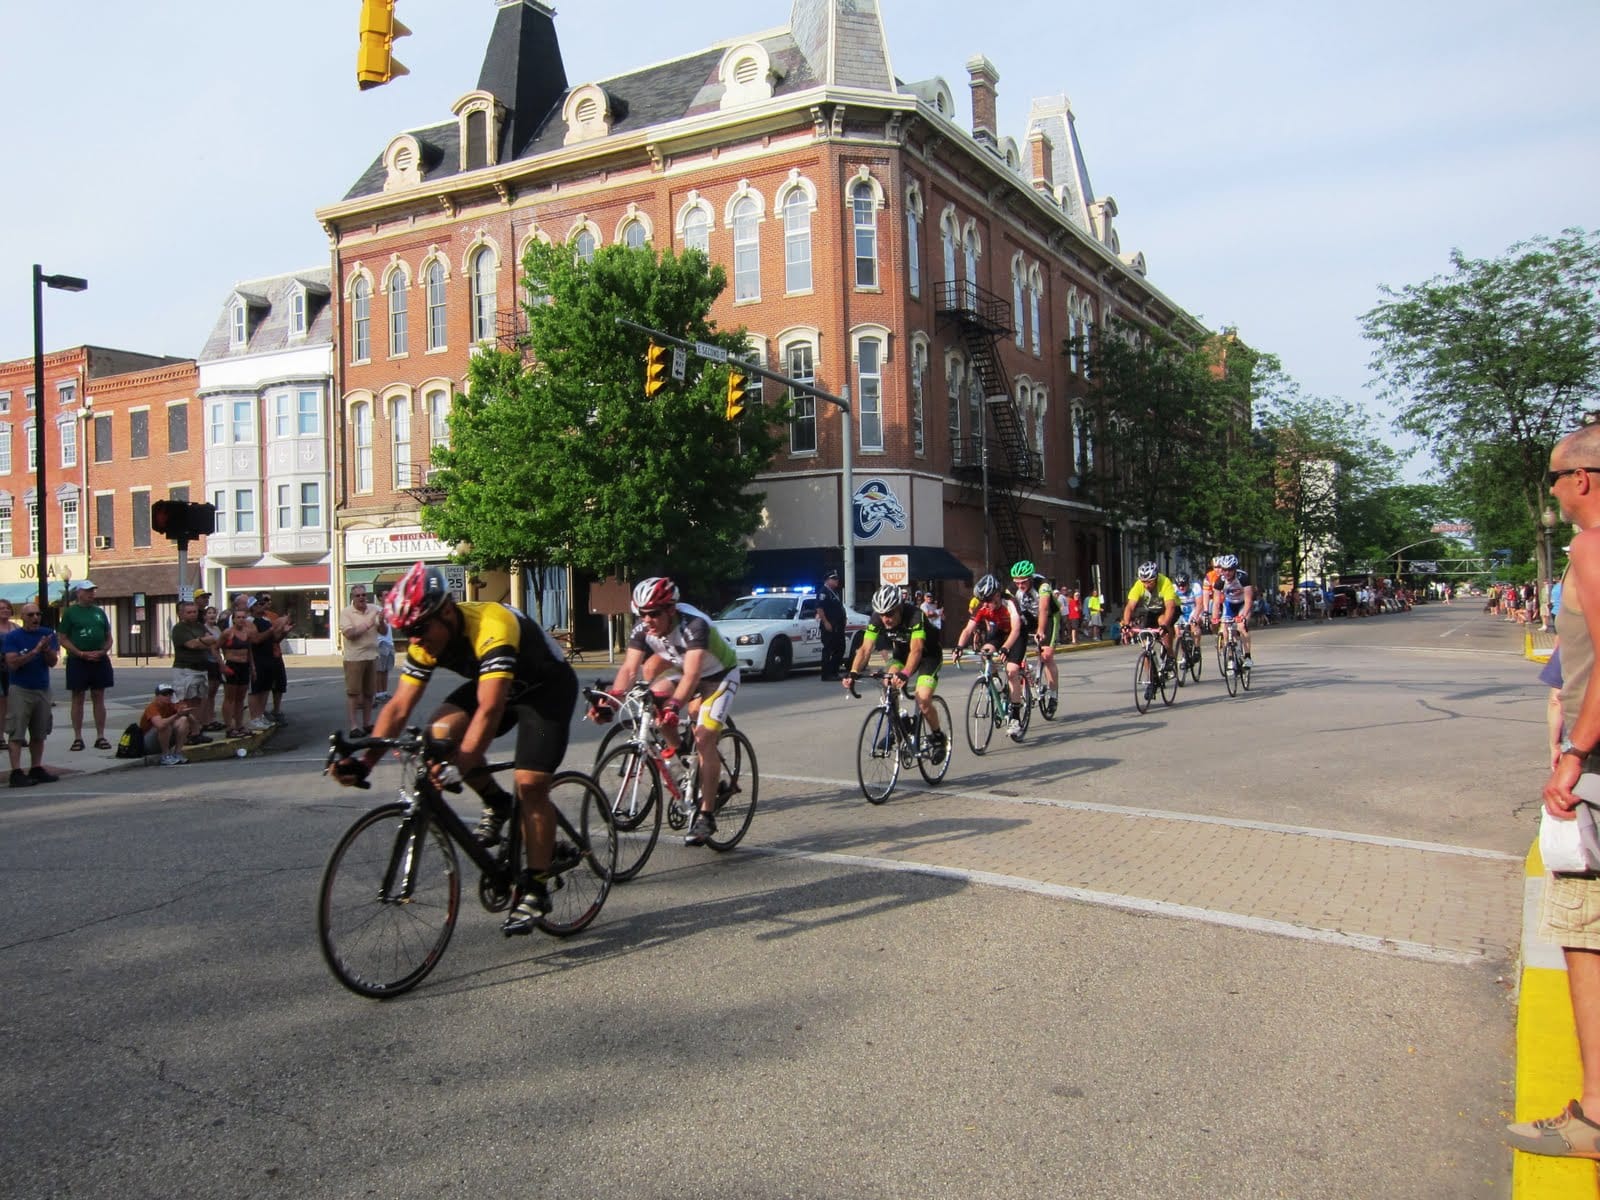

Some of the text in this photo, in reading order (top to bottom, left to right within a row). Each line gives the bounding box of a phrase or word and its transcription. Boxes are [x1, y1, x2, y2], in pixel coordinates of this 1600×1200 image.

[366, 540, 442, 554] FLESHMAN
[20, 563, 56, 578] SOA
[448, 578, 463, 589] 25
